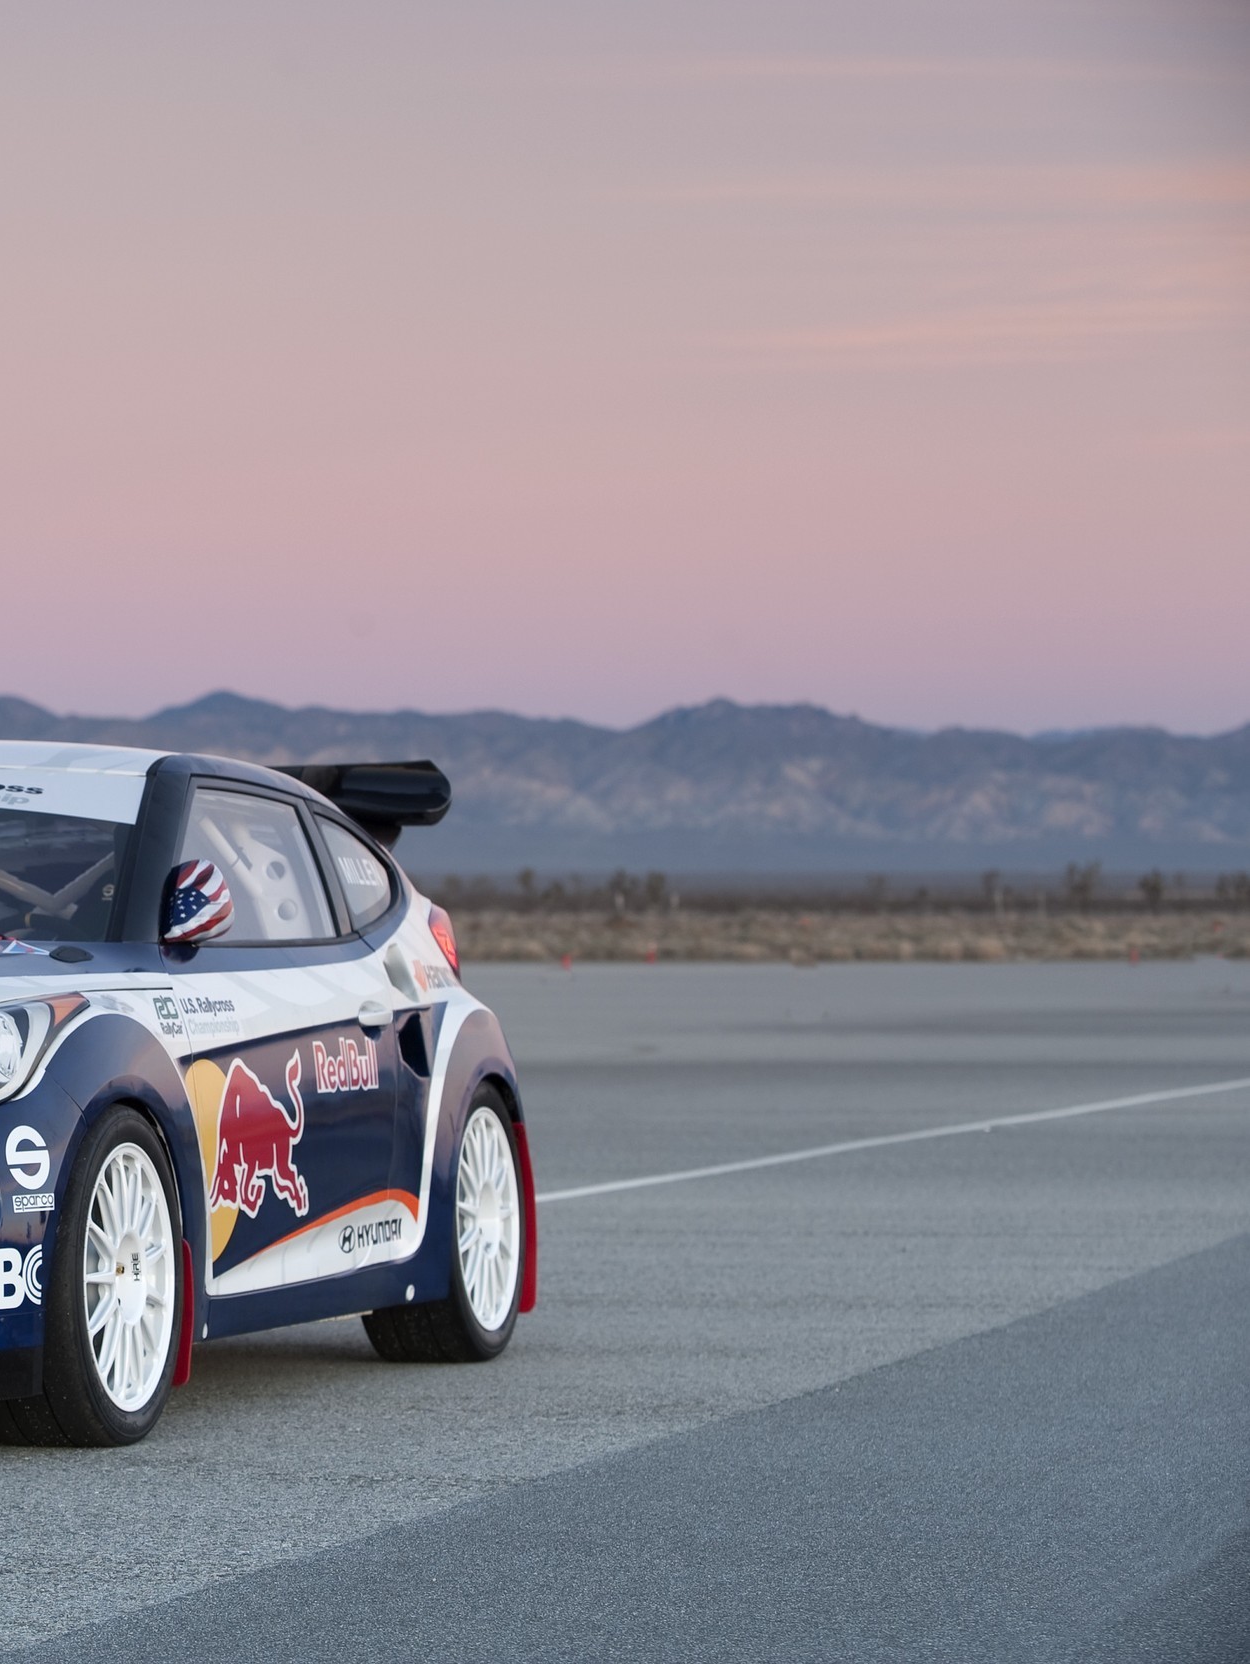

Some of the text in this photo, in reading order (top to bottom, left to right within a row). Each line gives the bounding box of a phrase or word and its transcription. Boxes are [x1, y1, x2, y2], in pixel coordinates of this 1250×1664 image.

[179, 997, 235, 1016] U.S. Rallycross
[188, 1018, 240, 1037] Championship
[313, 1037, 379, 1093] Red Bull
[14, 1194, 54, 1211] sparco
[357, 1218, 402, 1248] HYUNDAI
